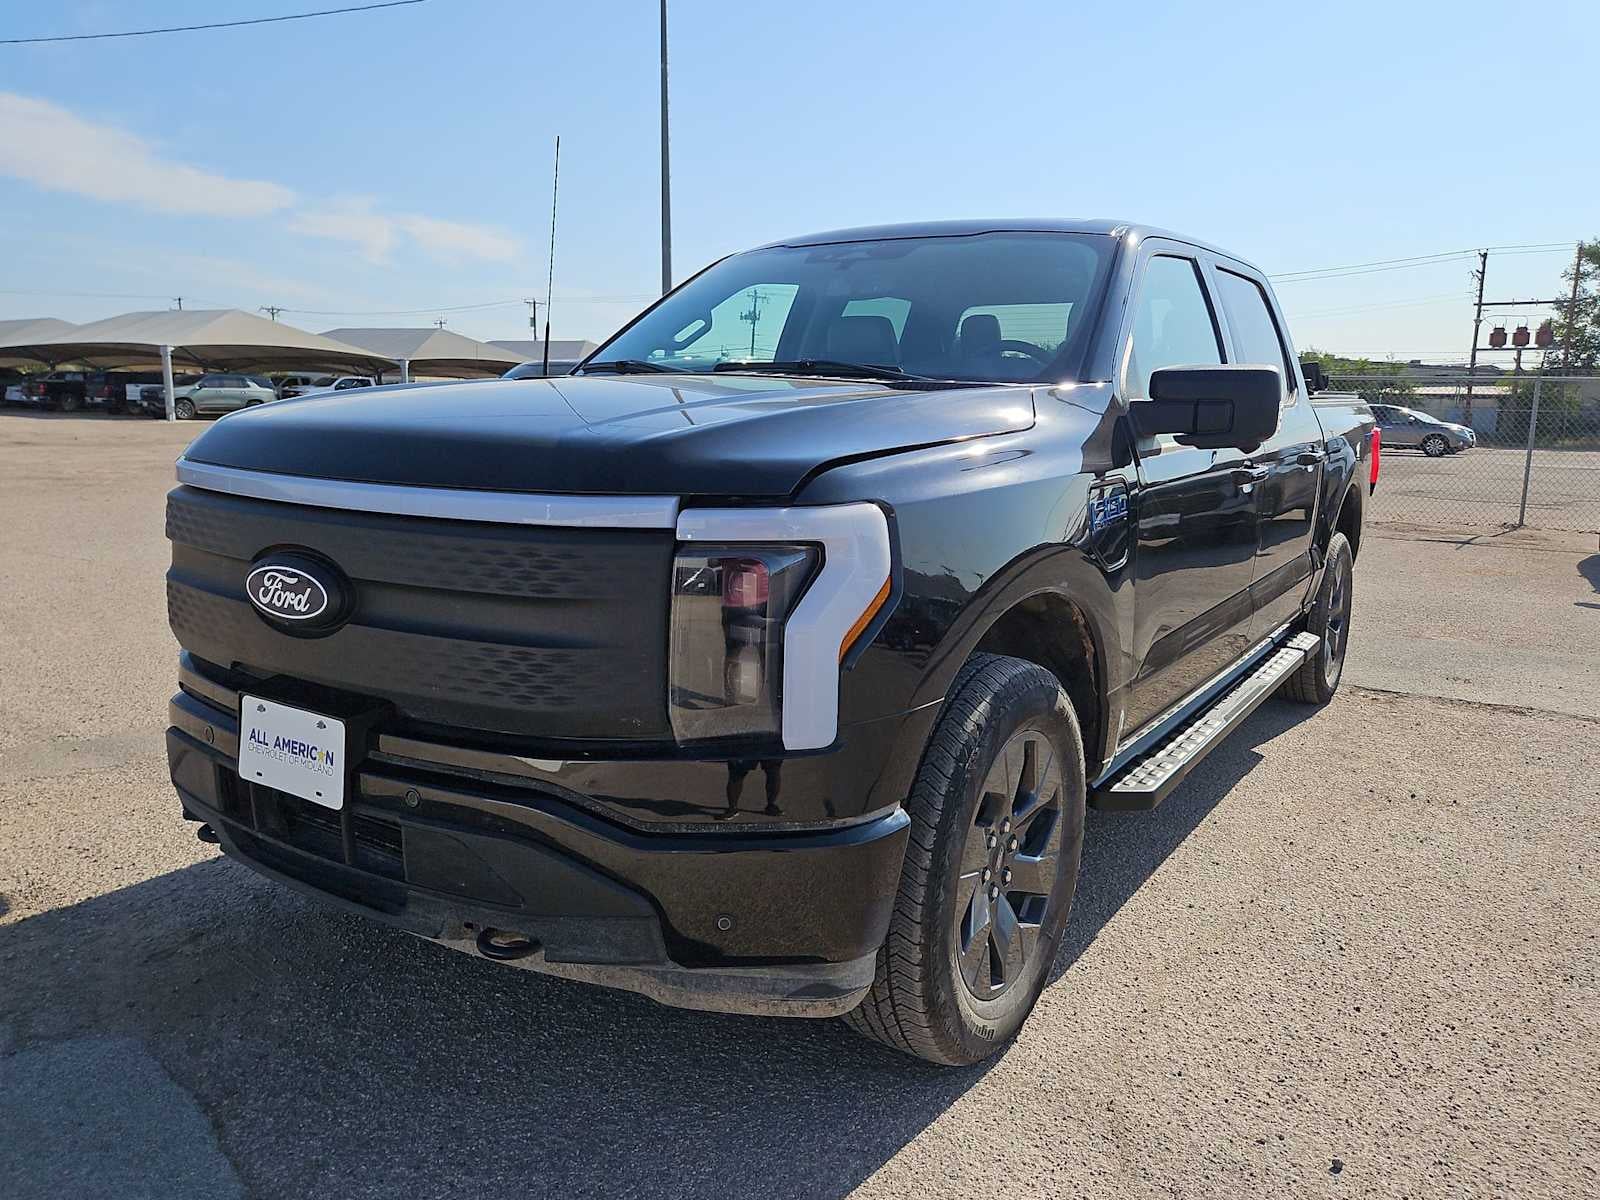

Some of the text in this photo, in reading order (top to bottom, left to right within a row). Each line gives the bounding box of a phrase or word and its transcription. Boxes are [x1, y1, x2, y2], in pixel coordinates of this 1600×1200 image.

[258, 571, 311, 612] Ford
[248, 742, 287, 763] CHEVROLET
[288, 754, 299, 765] OF
[249, 727, 334, 766] ALL AMERICN
